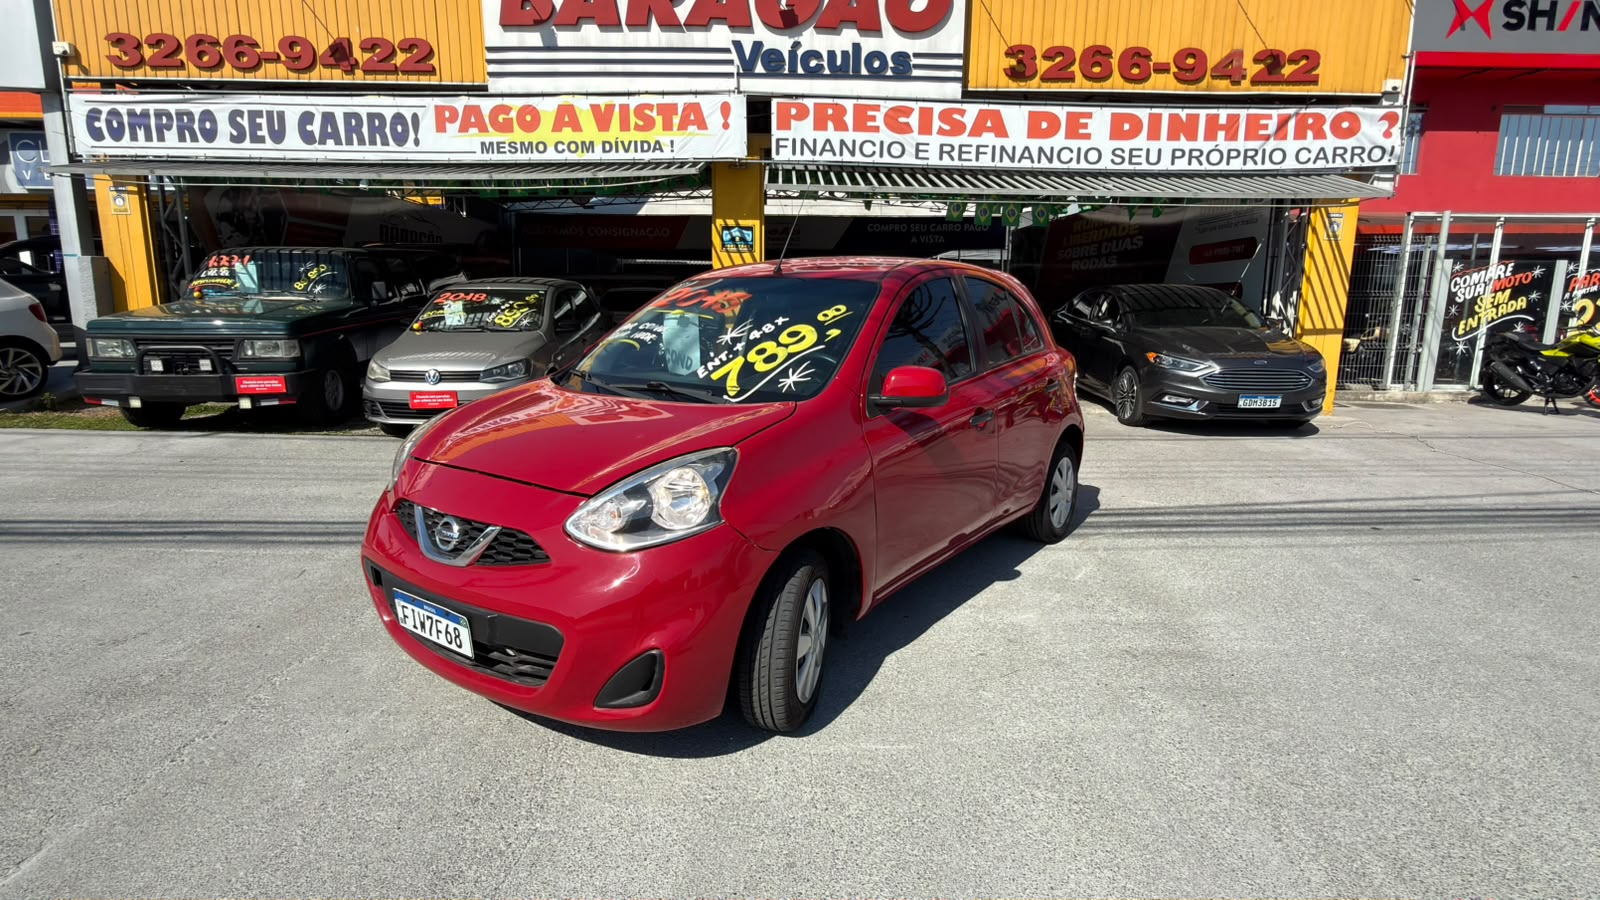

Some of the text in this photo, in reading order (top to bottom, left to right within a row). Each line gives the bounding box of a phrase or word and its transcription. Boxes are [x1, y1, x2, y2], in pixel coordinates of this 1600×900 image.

[104, 32, 436, 73] 3266-9422
[731, 40, 914, 76] Veículos
[1003, 44, 1321, 85] 3266-9422
[85, 107, 421, 148] COMPRO SEU CARRO!
[434, 103, 542, 134] PAGO
[551, 103, 583, 133] A
[589, 101, 710, 133] VISTA
[775, 102, 1010, 138] PRECISA
[1026, 110, 1093, 141] DE
[1108, 111, 1362, 142] DINHEIRO
[480, 140, 548, 155] MESMO
[553, 140, 596, 155] COM
[601, 137, 664, 154] DÍVIDA
[775, 137, 1396, 166] FINANCIO E REFINANCIO SEU PRÓPRIO CARRO!
[867, 223, 989, 233] COMPRO SEU CARRO PAGO
[921, 235, 945, 243] VISTA
[1062, 222, 1140, 248] LIBERDADE
[1056, 235, 1144, 260] SOBRE DUAS
[1071, 255, 1119, 271] RODAS
[433, 292, 487, 304] 2018
[1455, 271, 1533, 303] SUA MOTO
[1474, 288, 1512, 313] SEM
[1457, 296, 1528, 335] ENTRADA
[402, 605, 463, 649] FIW7F68
